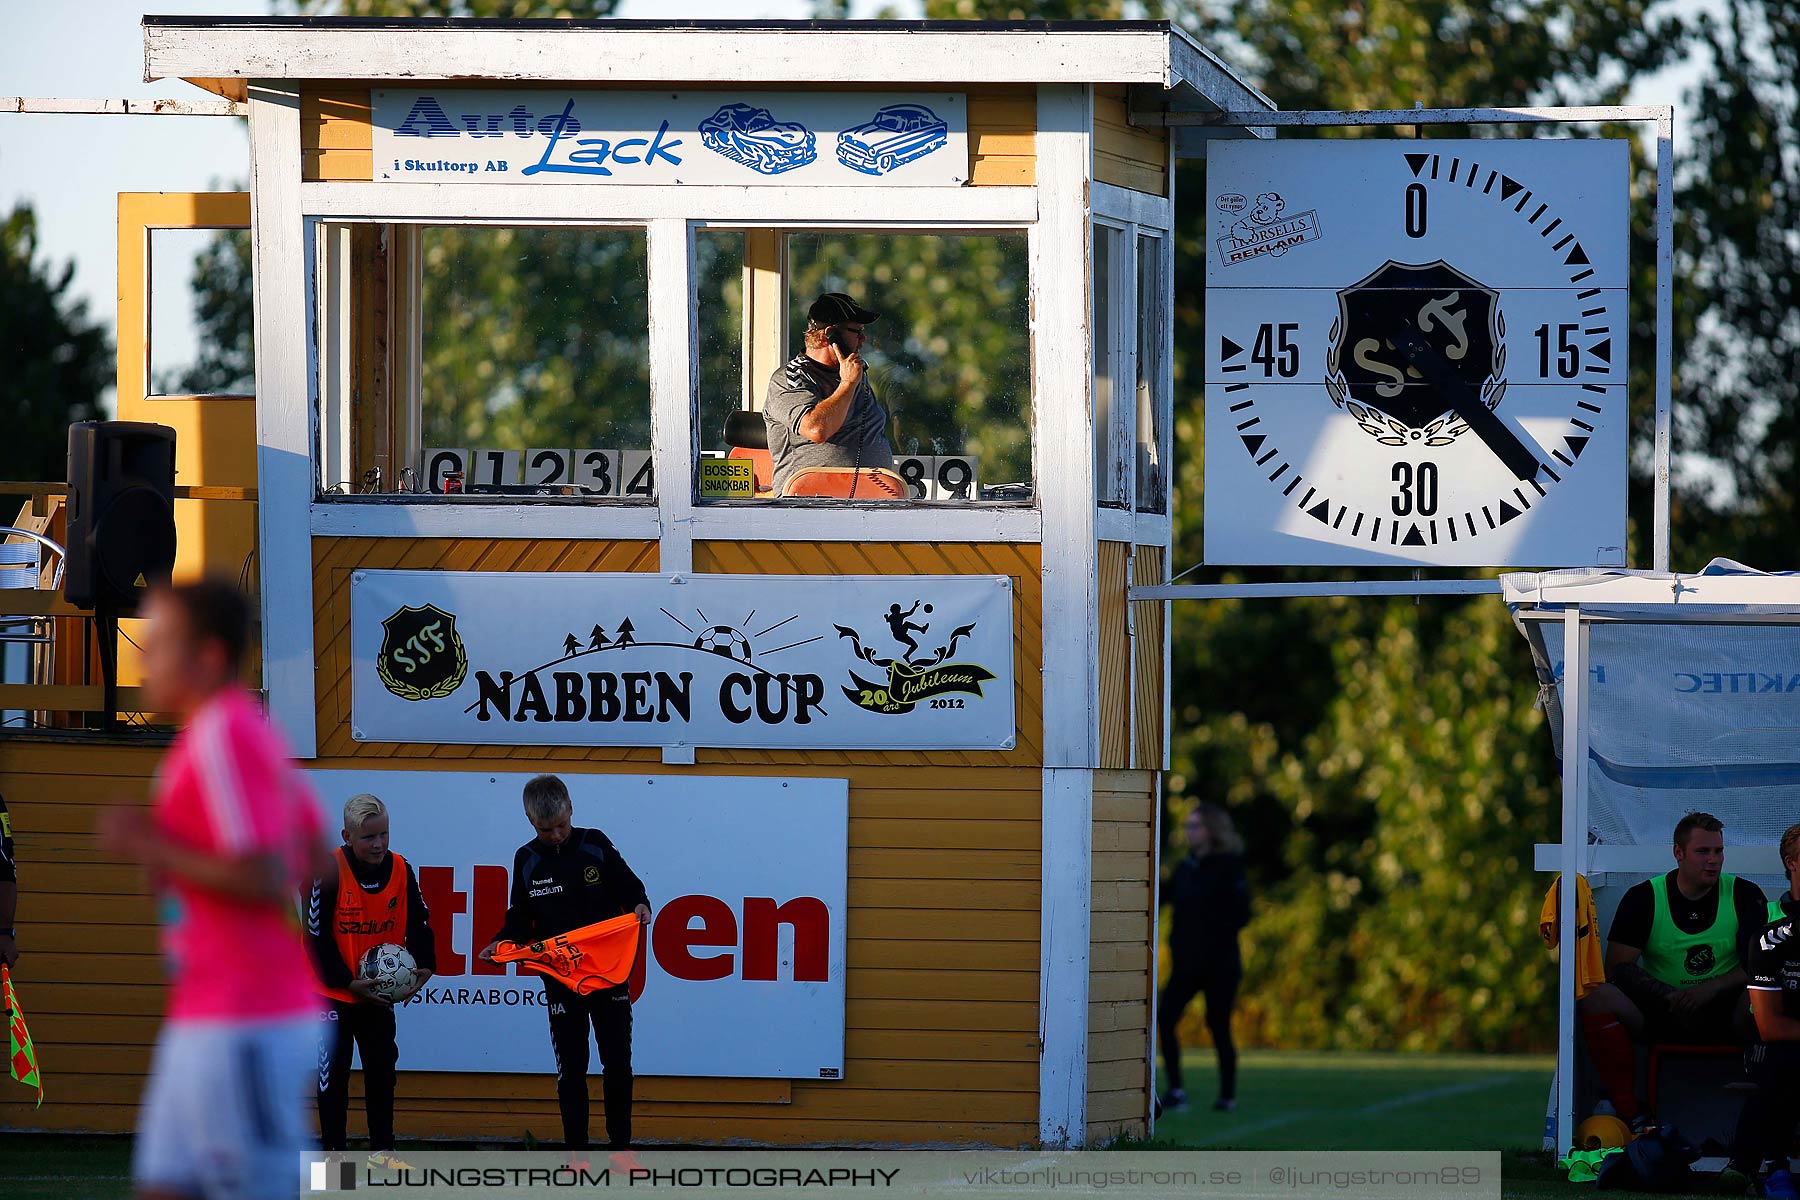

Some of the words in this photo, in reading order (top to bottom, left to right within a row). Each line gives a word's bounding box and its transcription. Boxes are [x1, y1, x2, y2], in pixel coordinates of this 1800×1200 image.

[393, 96, 581, 139] Auto
[521, 97, 683, 176] Lack
[393, 160, 401, 173] i
[404, 159, 479, 174] Skultorp
[483, 160, 509, 173] AB
[1405, 183, 1428, 239] 0
[1230, 234, 1305, 262] REKLAM
[1250, 322, 1299, 378] 45
[1534, 323, 1580, 378] 15
[582, 451, 612, 496] 3
[704, 465, 750, 477] BOSSE's
[704, 479, 750, 492] SNACKBAR
[898, 457, 928, 500] 8
[937, 458, 973, 500] 9
[1390, 461, 1439, 516] 30
[474, 670, 691, 724] NABBEN
[719, 670, 826, 725] CUP
[859, 689, 888, 707] 20
[902, 671, 974, 702] Jubileum
[929, 698, 965, 710] 2012
[528, 884, 564, 898] stadium
